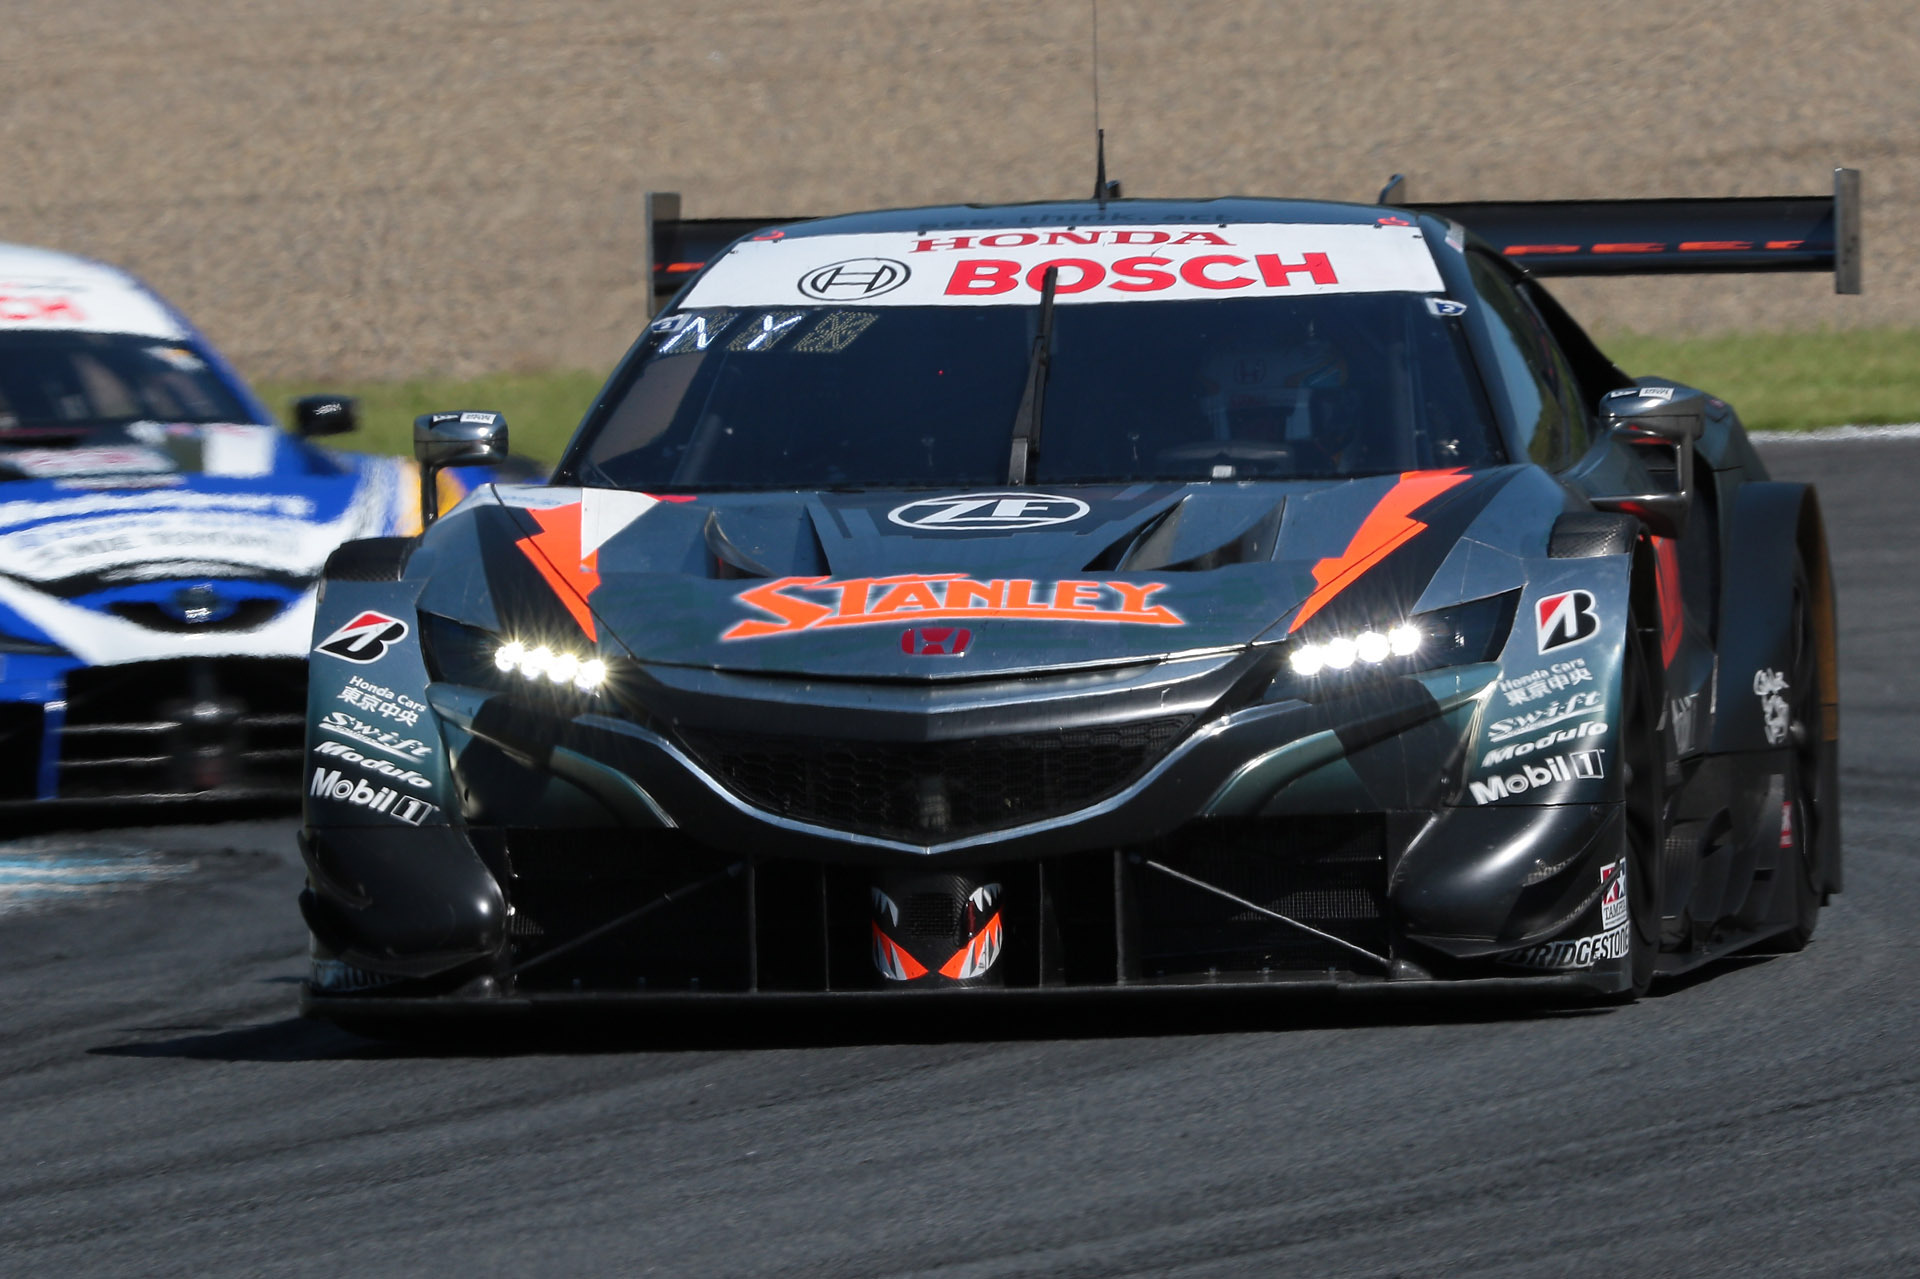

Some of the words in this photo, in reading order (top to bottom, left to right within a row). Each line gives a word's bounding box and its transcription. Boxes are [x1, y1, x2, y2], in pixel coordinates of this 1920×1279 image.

[908, 230, 1237, 253] HONDA
[943, 252, 1339, 296] BOSCH
[913, 499, 1070, 524] ZF
[720, 573, 1186, 642] STANLEY
[348, 675, 396, 701] Honda
[397, 694, 427, 713] Cars
[1500, 668, 1549, 693] Honda
[1550, 658, 1586, 675] Cars
[336, 685, 420, 727] 東京中央
[313, 740, 433, 788] Modulo
[1480, 720, 1609, 768] Modulo
[310, 767, 399, 813] Mobil
[1468, 755, 1572, 805] Mobil
